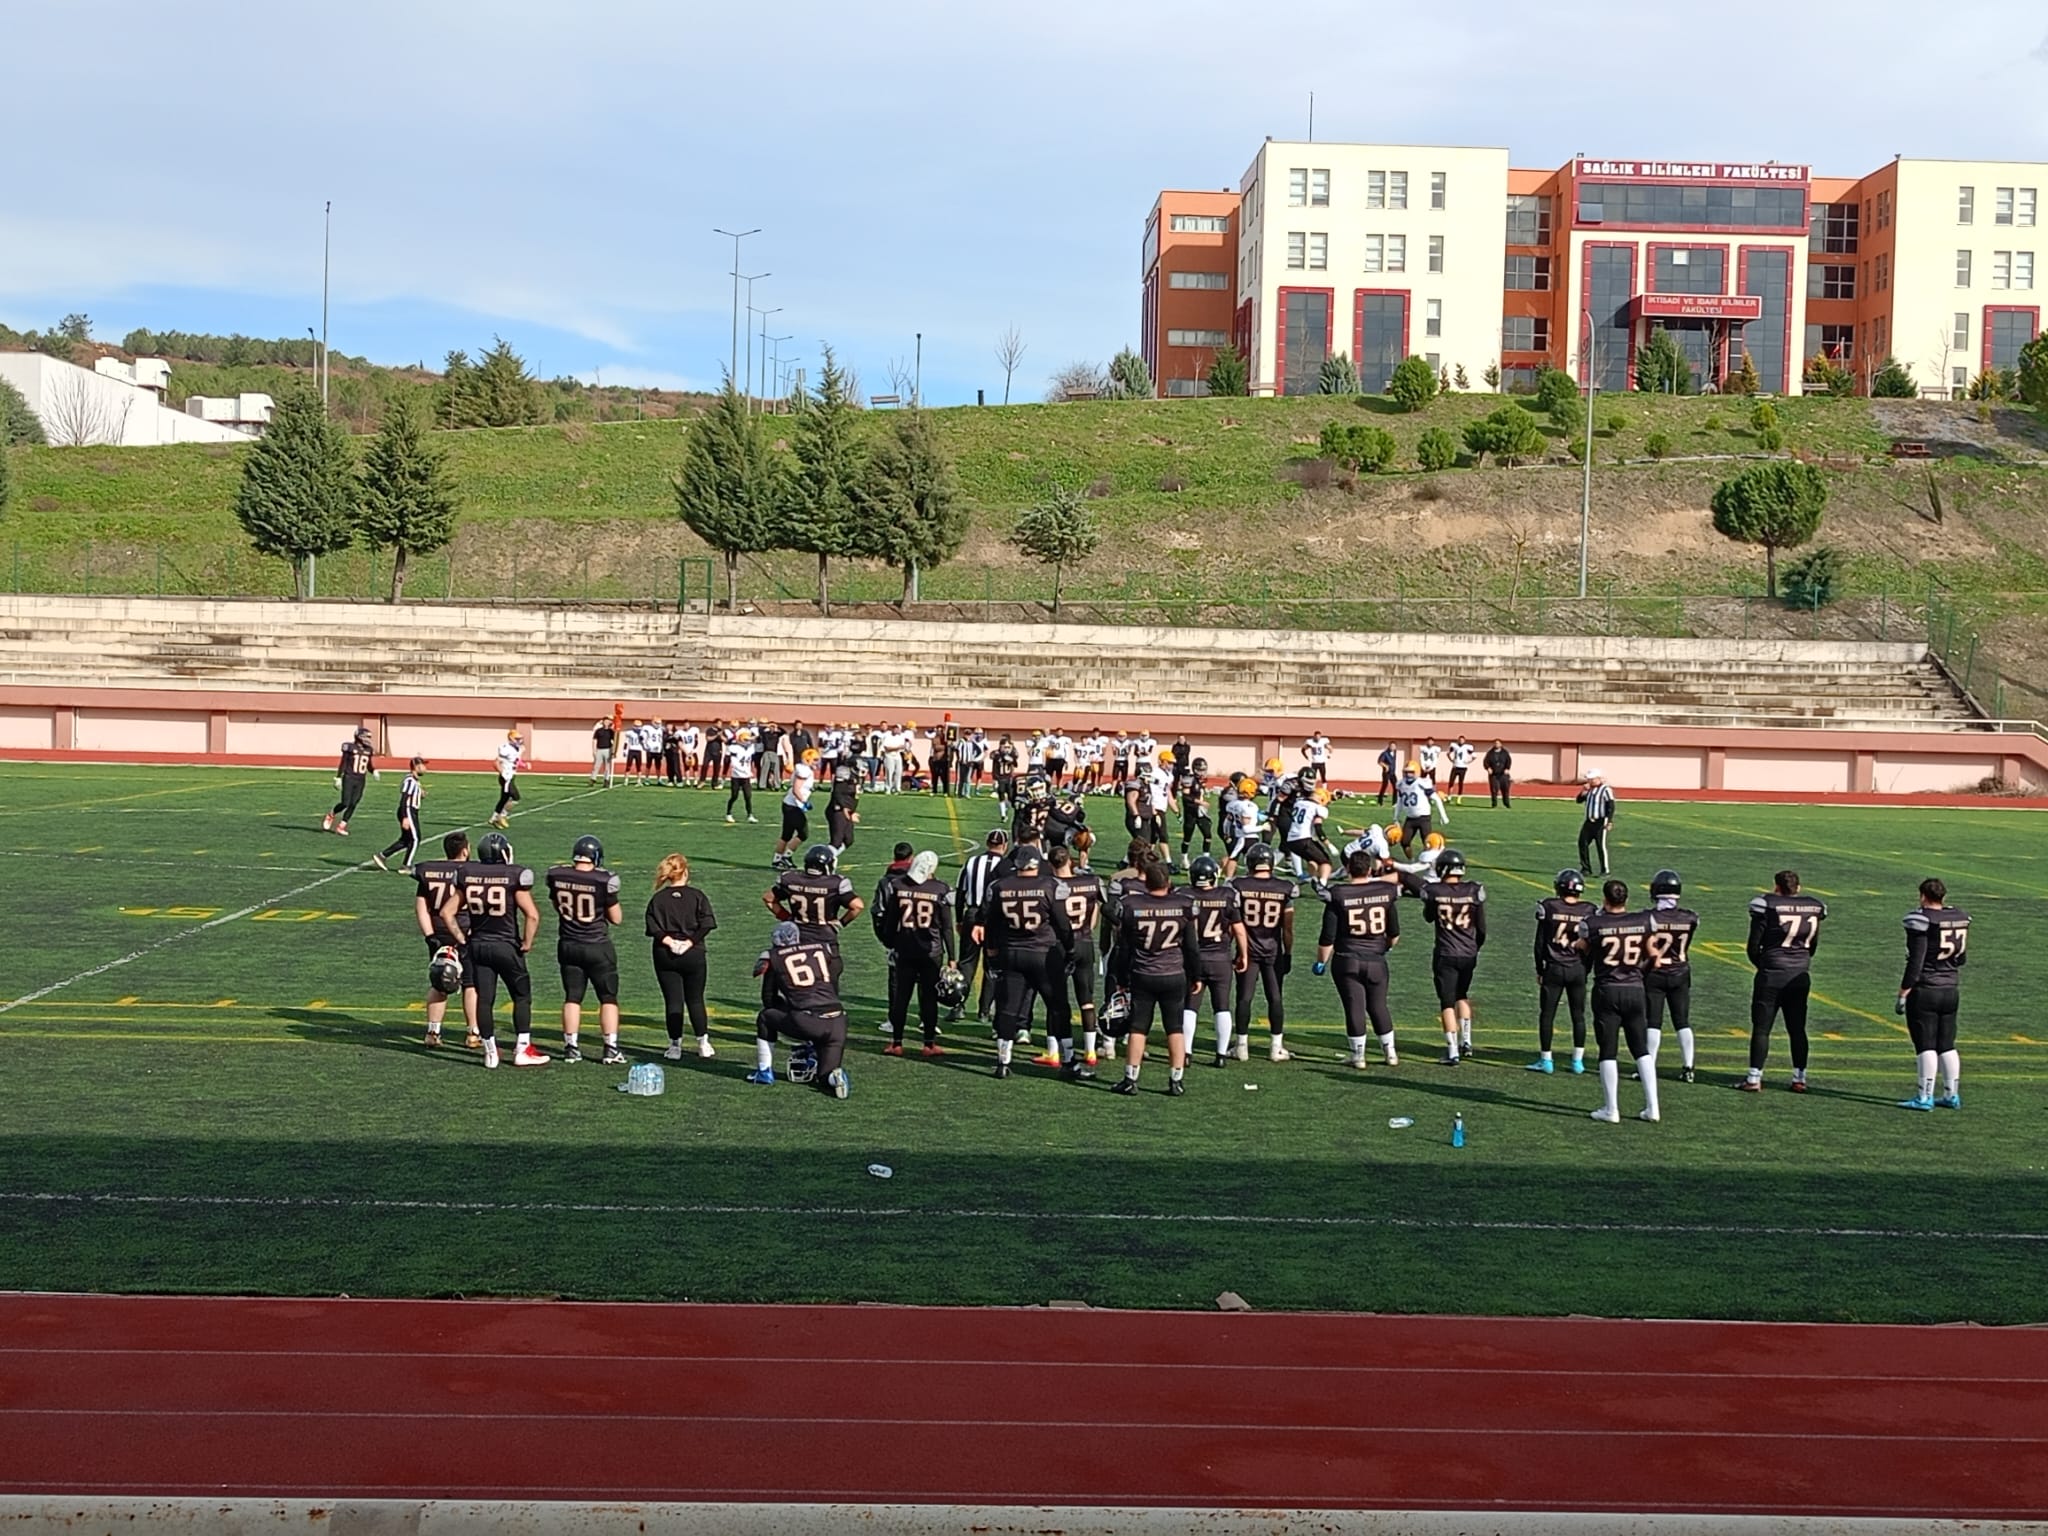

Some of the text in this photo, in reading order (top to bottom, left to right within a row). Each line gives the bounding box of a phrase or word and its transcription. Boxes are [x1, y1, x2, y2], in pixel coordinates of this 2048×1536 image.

[1582, 161, 1802, 179] SAĞLIK BİLİMLERİ FAKÜLTESİ
[353, 755, 369, 774] 18
[466, 885, 506, 916] 69
[557, 890, 596, 922] 80
[899, 898, 933, 928] 28
[1002, 900, 1041, 930] 55
[1244, 899, 1281, 929] 88
[1137, 920, 1180, 950] 72
[1348, 906, 1385, 935] 58
[1779, 915, 1818, 948] 71
[1601, 936, 1642, 966] 26
[1652, 932, 1690, 964] 21
[1937, 928, 1967, 960] 57
[785, 951, 830, 986] 61
